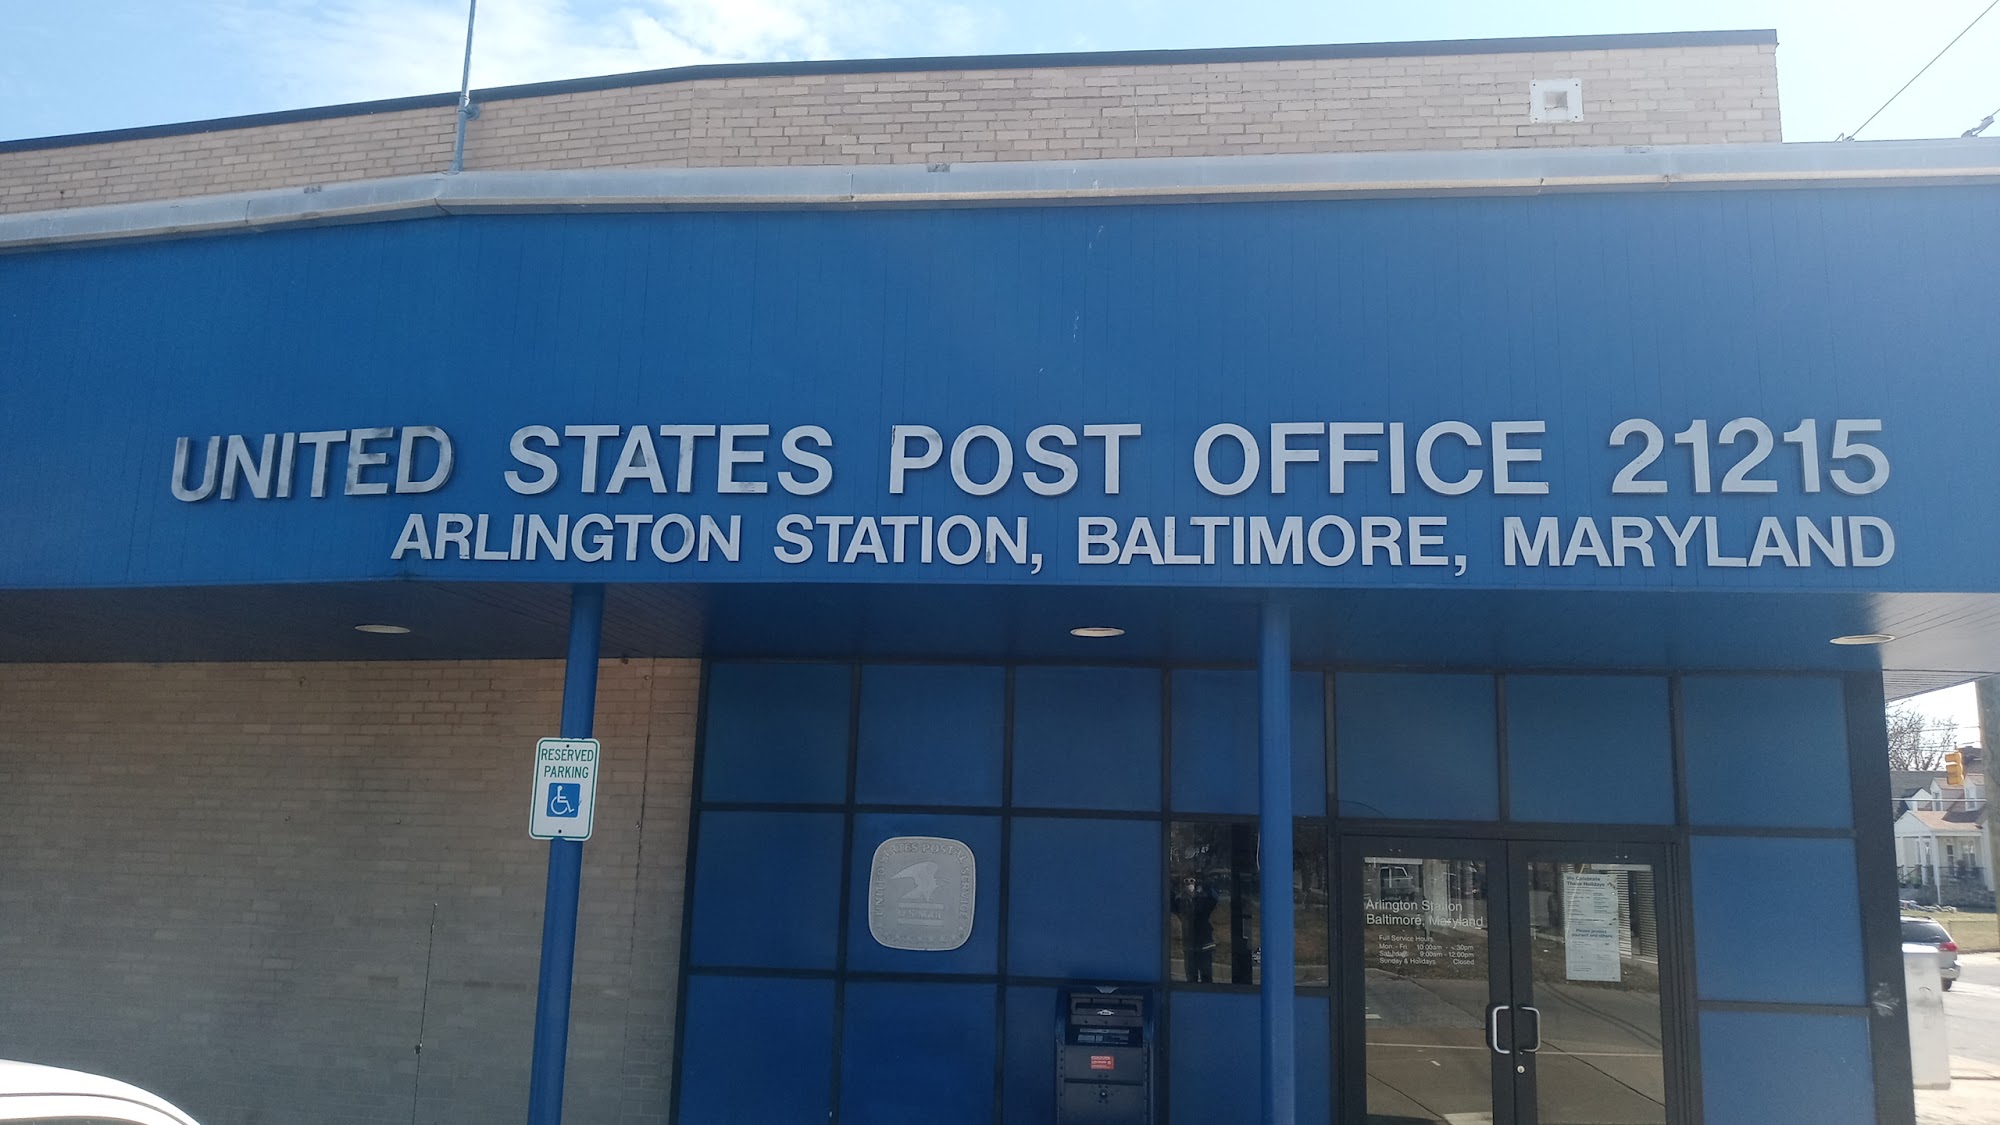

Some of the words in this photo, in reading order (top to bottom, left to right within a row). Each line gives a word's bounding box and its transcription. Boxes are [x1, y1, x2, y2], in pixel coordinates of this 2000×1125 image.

[170, 425, 455, 502] UNITED
[504, 423, 833, 496] STATES
[889, 423, 1142, 496] POST
[1193, 420, 1550, 497] OFFICE
[1608, 417, 1891, 497] 21215
[390, 512, 742, 562] ARLINGTON
[773, 513, 1043, 575] STATION,
[1077, 515, 1467, 578] BALTIMORE,
[1503, 515, 1896, 568] MARYLAND
[541, 749, 594, 761] RESERVED
[544, 766, 589, 778] PARKING
[921, 843, 968, 863] POSTAL
[960, 866, 971, 919] SERVICE
[1366, 899, 1418, 913] Arlington
[1366, 913, 1425, 926] Baltimore,
[1430, 916, 1483, 928] Maryland
